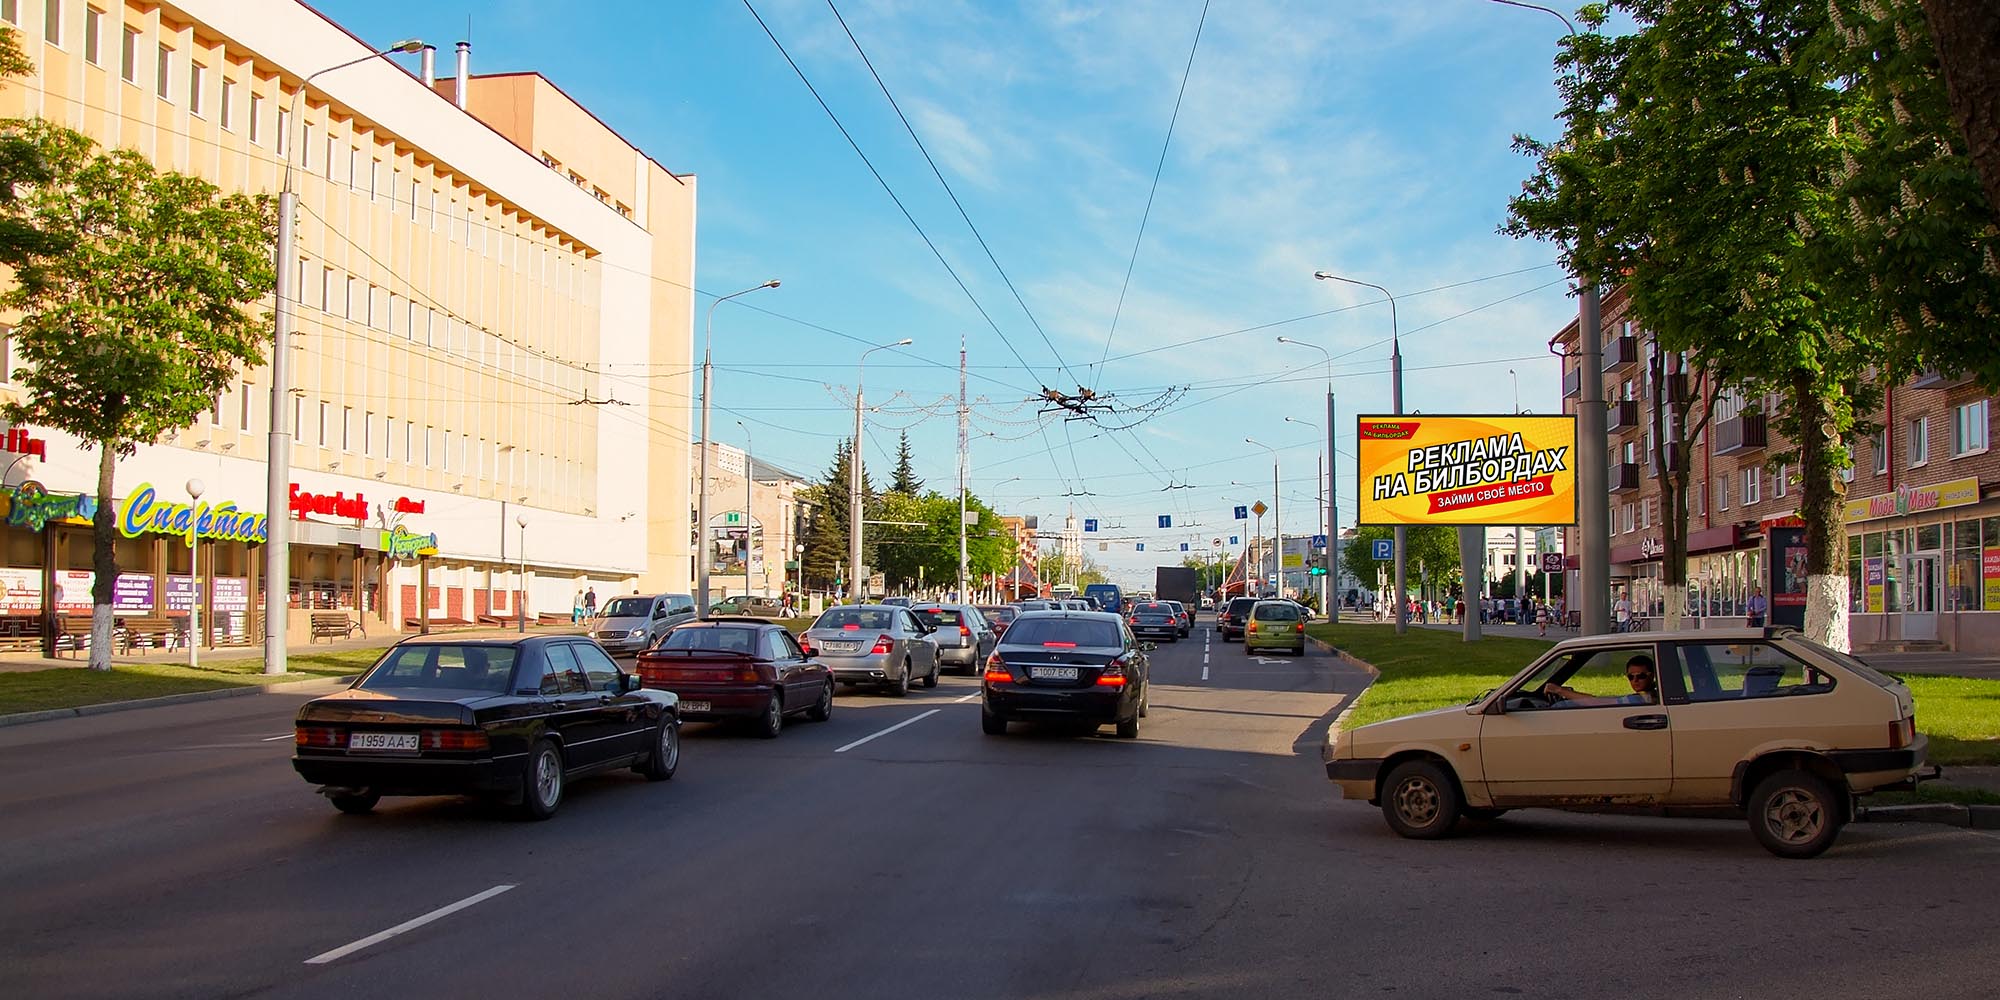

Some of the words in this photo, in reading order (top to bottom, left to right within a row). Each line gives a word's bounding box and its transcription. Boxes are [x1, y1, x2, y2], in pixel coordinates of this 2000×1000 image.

[1373, 430, 1409, 439] БИЛБОРДАХ
[1408, 433, 1525, 473] РЕКЛАМА
[1373, 471, 1409, 501] НА
[1414, 446, 1569, 495] БИЛБОРДАХ
[1437, 492, 1475, 508] ЗАЙМИ
[1476, 486, 1506, 502] СВОЁ
[1507, 480, 1544, 496] МЕСТО
[1869, 497, 1895, 517] Мода
[1908, 490, 1939, 512] Макс
[361, 735, 386, 748] 1959
[387, 735, 418, 749] AA-3
